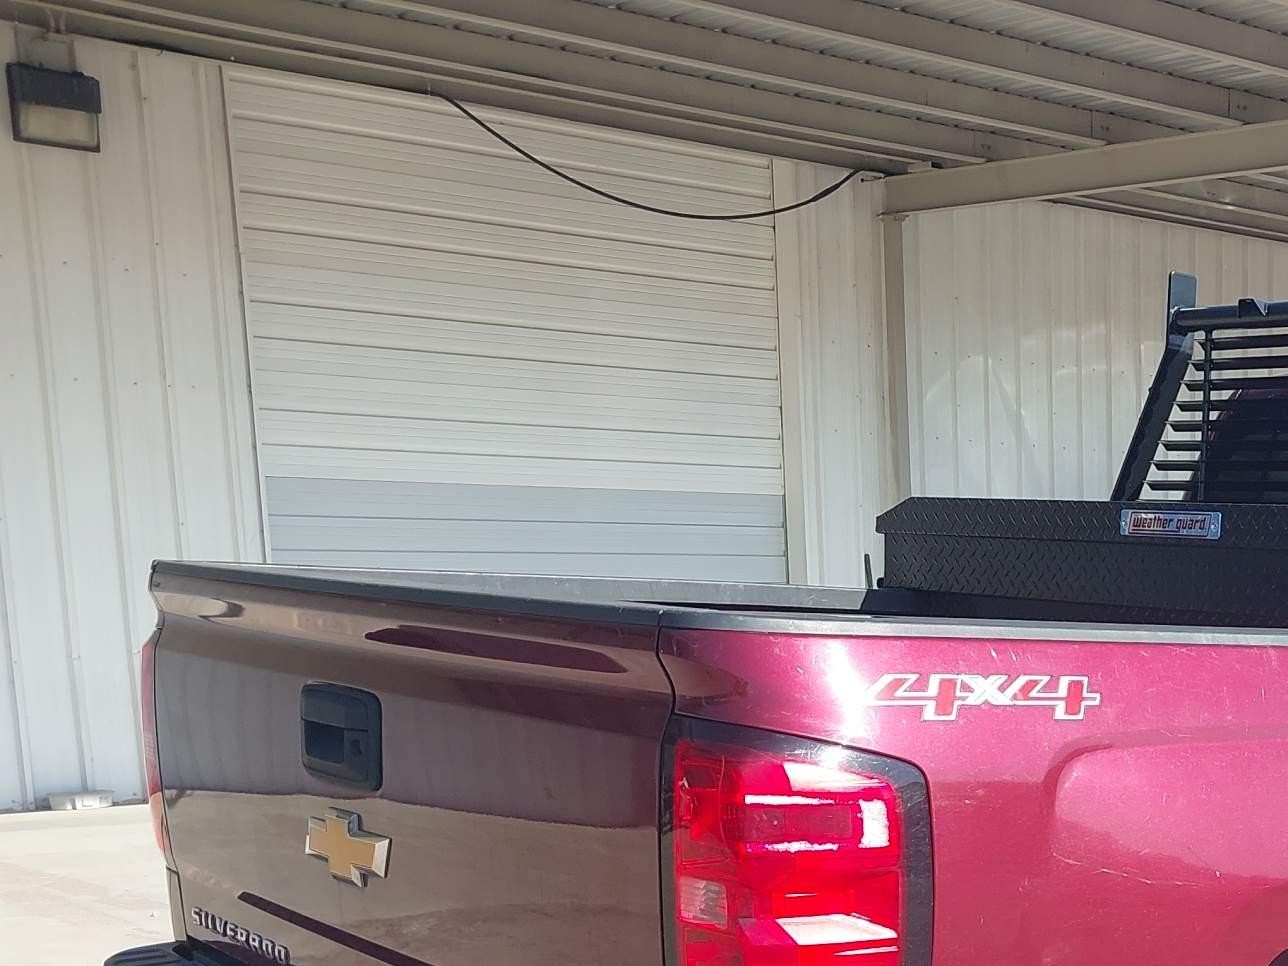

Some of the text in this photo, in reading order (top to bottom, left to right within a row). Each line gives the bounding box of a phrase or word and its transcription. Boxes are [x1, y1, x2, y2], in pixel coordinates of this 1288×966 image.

[1132, 515, 1206, 532] weather guard
[191, 906, 290, 965] SILVERADO
